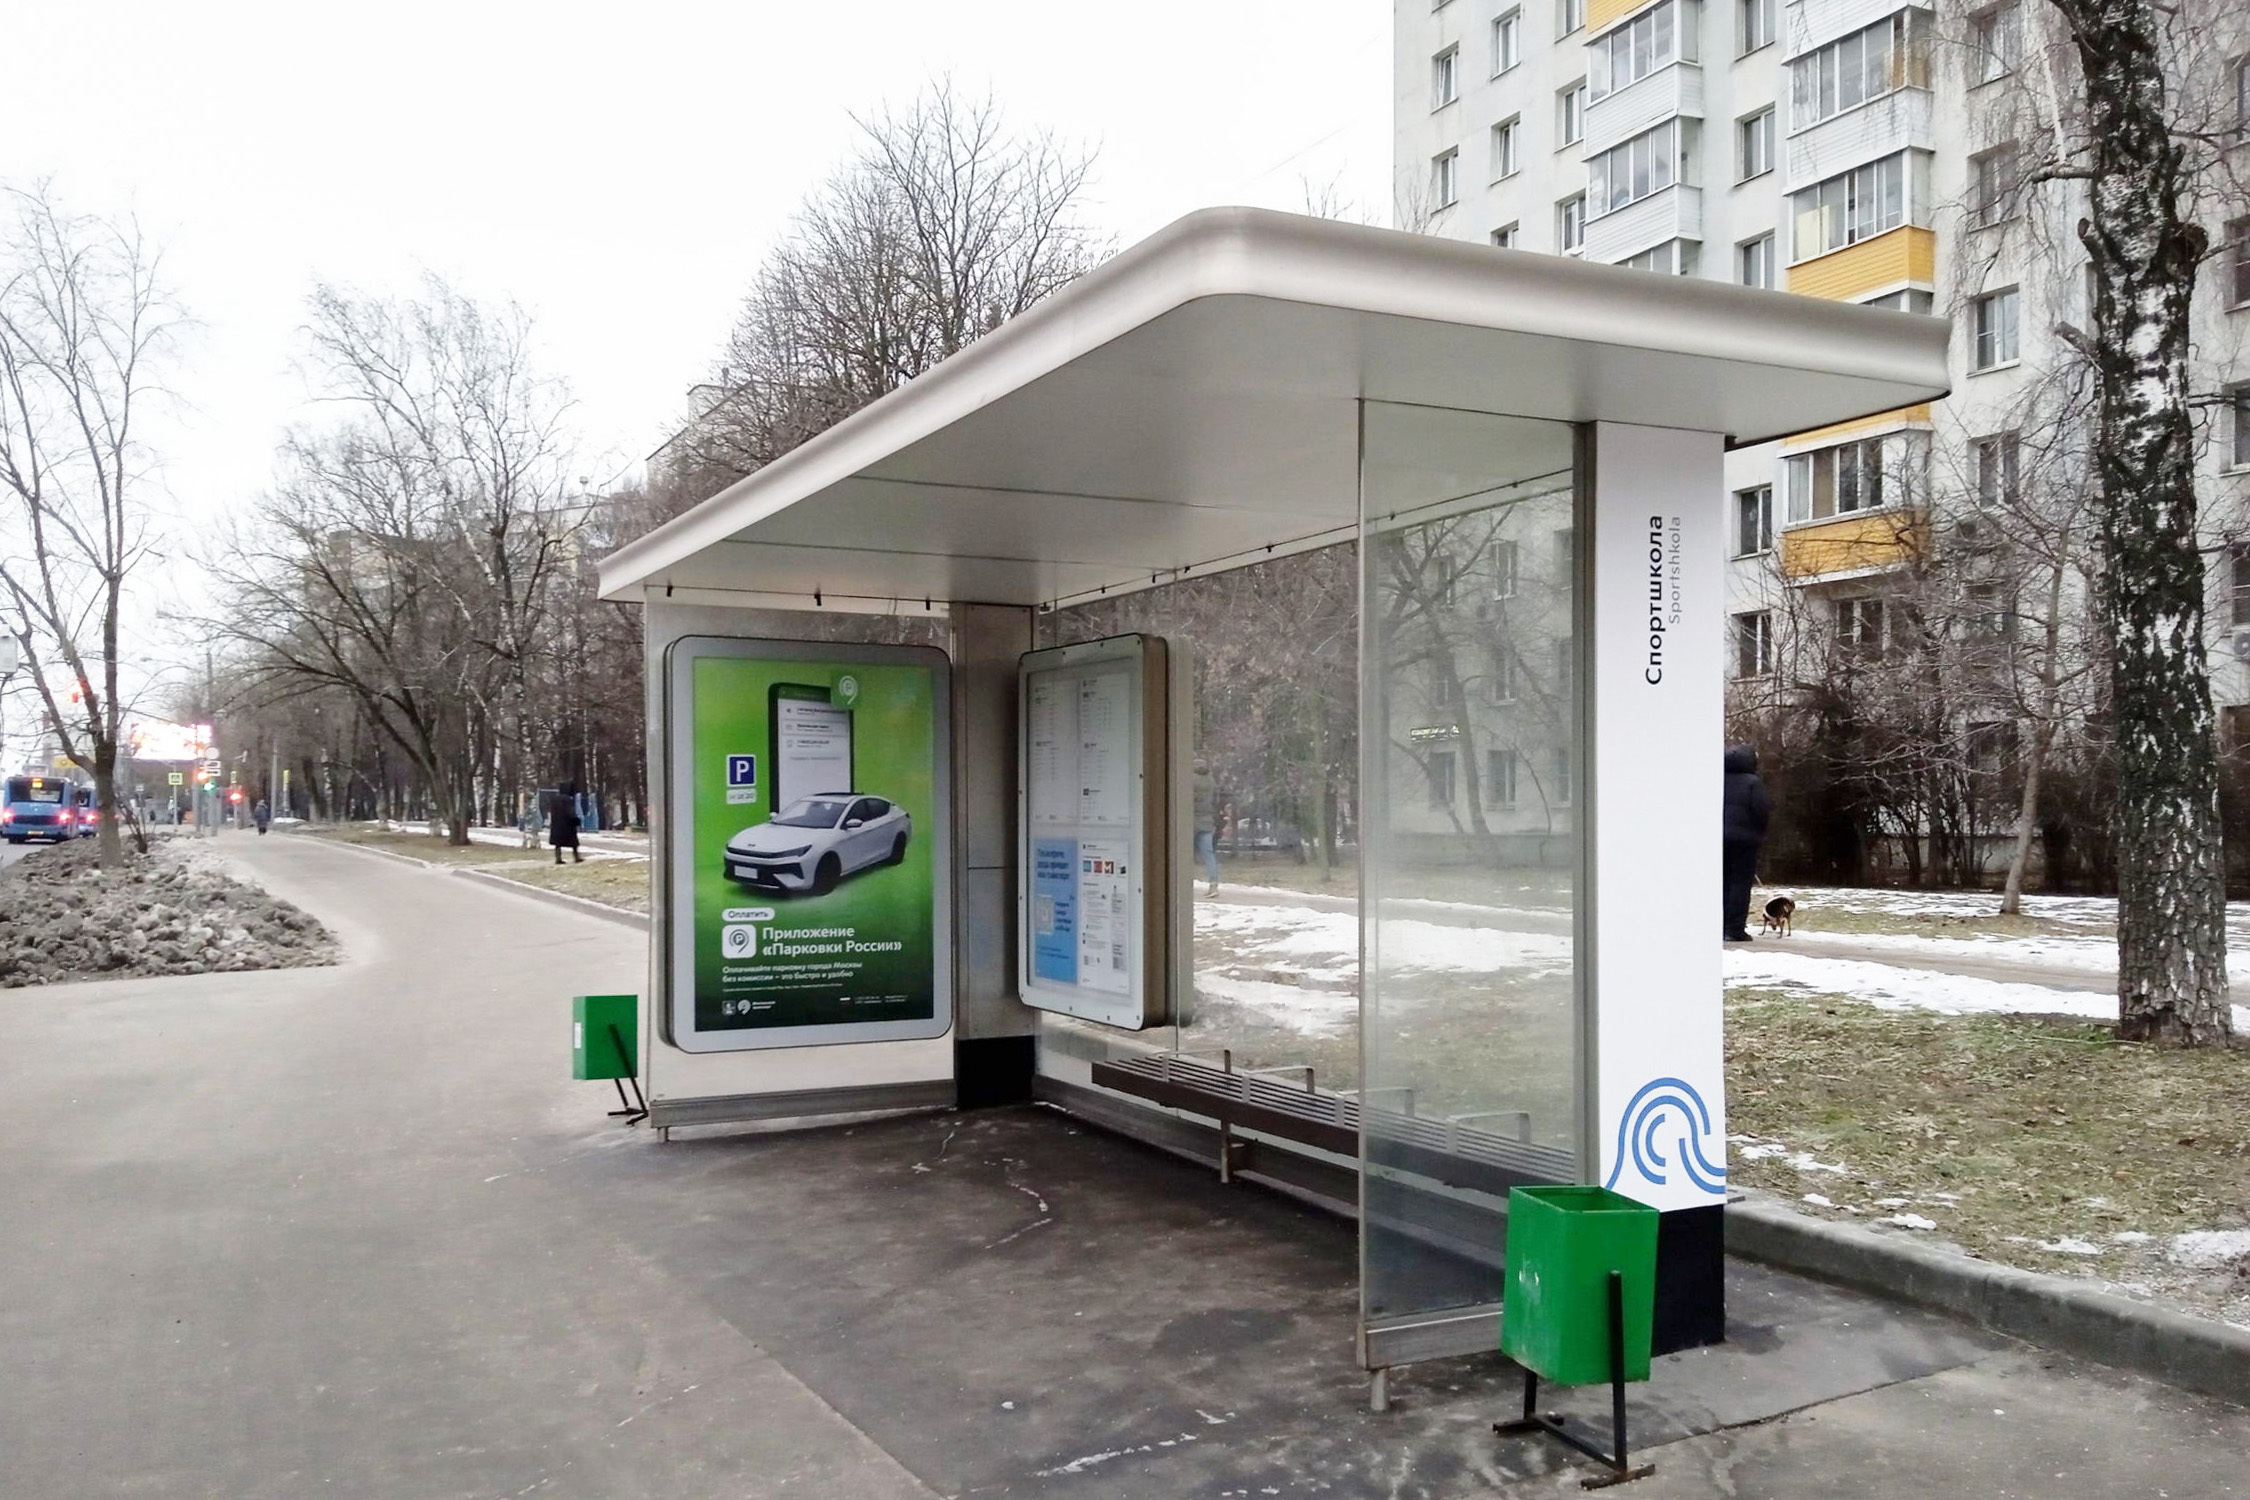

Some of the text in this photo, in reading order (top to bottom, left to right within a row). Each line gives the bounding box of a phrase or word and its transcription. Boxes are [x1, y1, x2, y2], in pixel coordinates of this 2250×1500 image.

[1668, 516, 1683, 624] Sportshkola
[1645, 515, 1666, 685] Спортшкола
[736, 760, 750, 782] P
[728, 910, 769, 919] Оплатить
[762, 926, 855, 942] Приложение
[762, 940, 902, 957] «Парковки России»
[722, 961, 863, 974] Оплачивайте парковку города Москвы
[722, 974, 736, 983] без
[738, 974, 773, 982] комиссии
[794, 971, 820, 981] быстро
[827, 970, 854, 980] удобно
